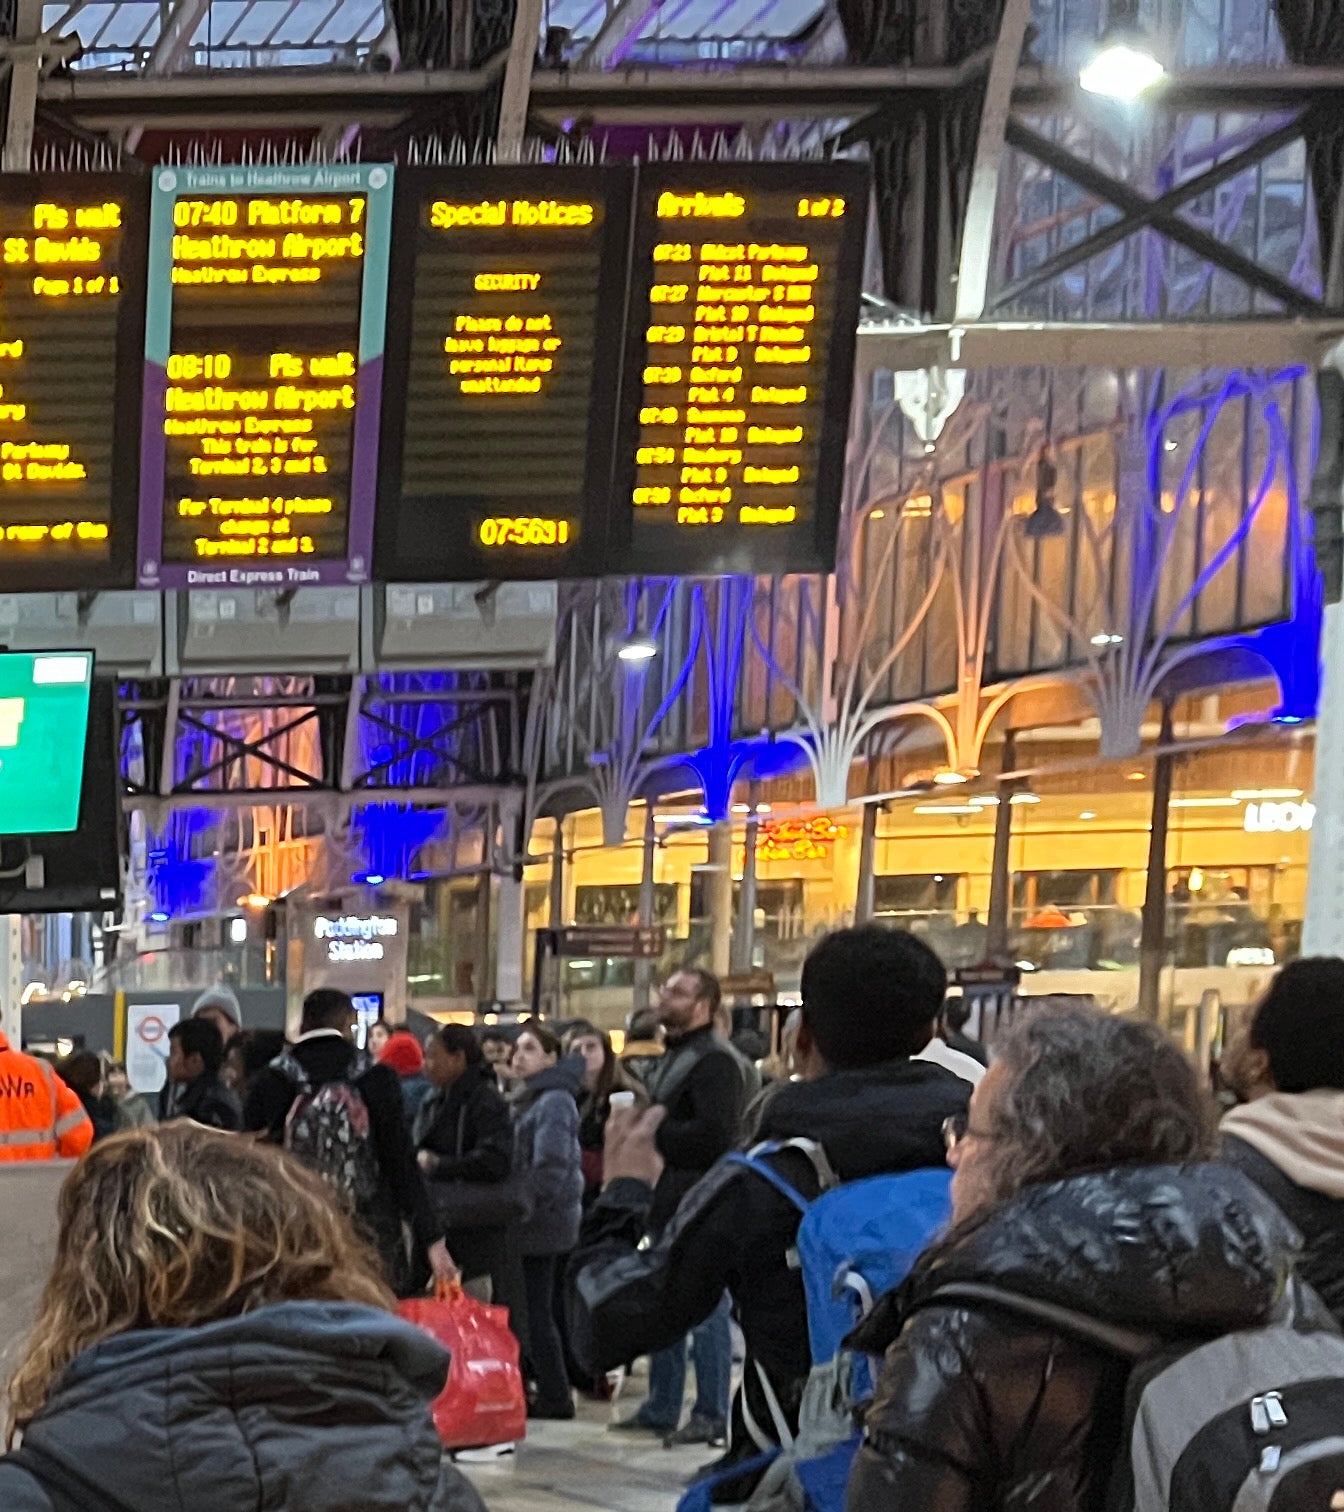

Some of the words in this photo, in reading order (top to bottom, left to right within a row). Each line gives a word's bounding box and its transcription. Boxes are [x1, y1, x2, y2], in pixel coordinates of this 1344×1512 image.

[188, 173, 225, 187] Trains
[230, 172, 244, 187] to
[248, 173, 311, 186] Heathrow
[314, 172, 360, 188] Airport
[34, 204, 68, 229] Pls
[76, 203, 121, 229] wait
[174, 201, 237, 226] 07:40
[249, 200, 341, 225] Platform
[349, 199, 364, 223] 7
[431, 201, 505, 228] Special
[512, 201, 592, 225] Notices
[657, 192, 745, 217] Arrivals
[4, 238, 29, 263] St
[35, 237, 100, 263] Davids
[173, 235, 276, 259] Heathrow
[283, 233, 363, 259] Airport
[475, 274, 540, 290] SECURITY
[167, 354, 230, 379] 08:10
[270, 353, 303, 377] Pls
[310, 353, 355, 377] wait
[166, 387, 268, 411] Heathrow
[274, 385, 354, 410] Airport
[188, 570, 226, 583] Direct
[230, 569, 283, 583] Express
[288, 568, 319, 580] Train
[315, 916, 397, 939] Paddington
[329, 940, 383, 960] Station
